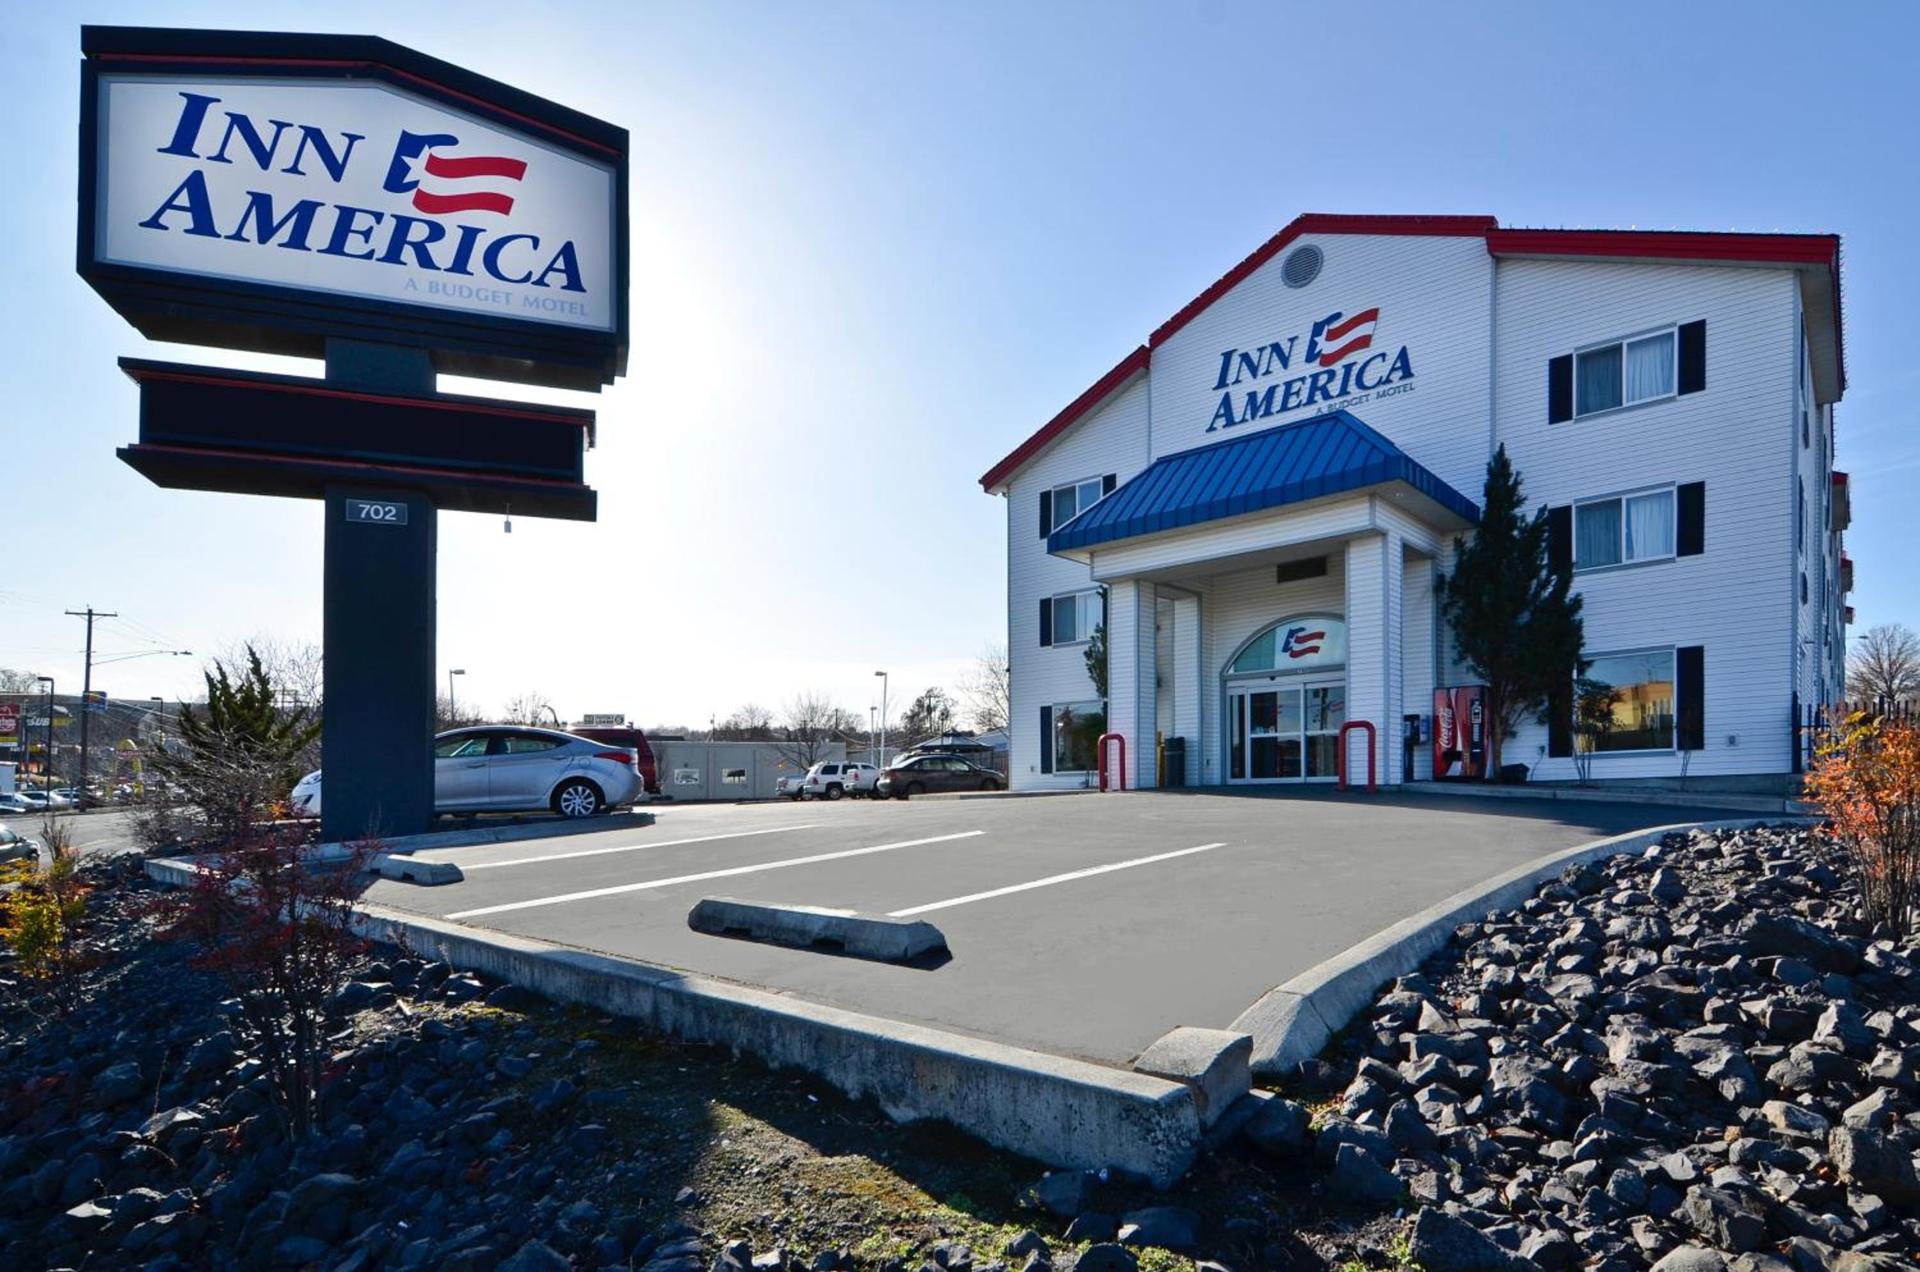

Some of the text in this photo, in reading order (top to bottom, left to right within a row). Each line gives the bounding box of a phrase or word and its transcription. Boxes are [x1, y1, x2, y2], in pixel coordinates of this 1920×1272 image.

[157, 91, 366, 183] INN
[138, 169, 588, 294] AMERICA
[404, 277, 589, 317] A BUDGET MOTEL
[1205, 345, 1415, 433] AMERICA
[1212, 335, 1299, 391] INN
[1315, 382, 1415, 416] A BUDGET MOTEL
[358, 504, 397, 521] 702
